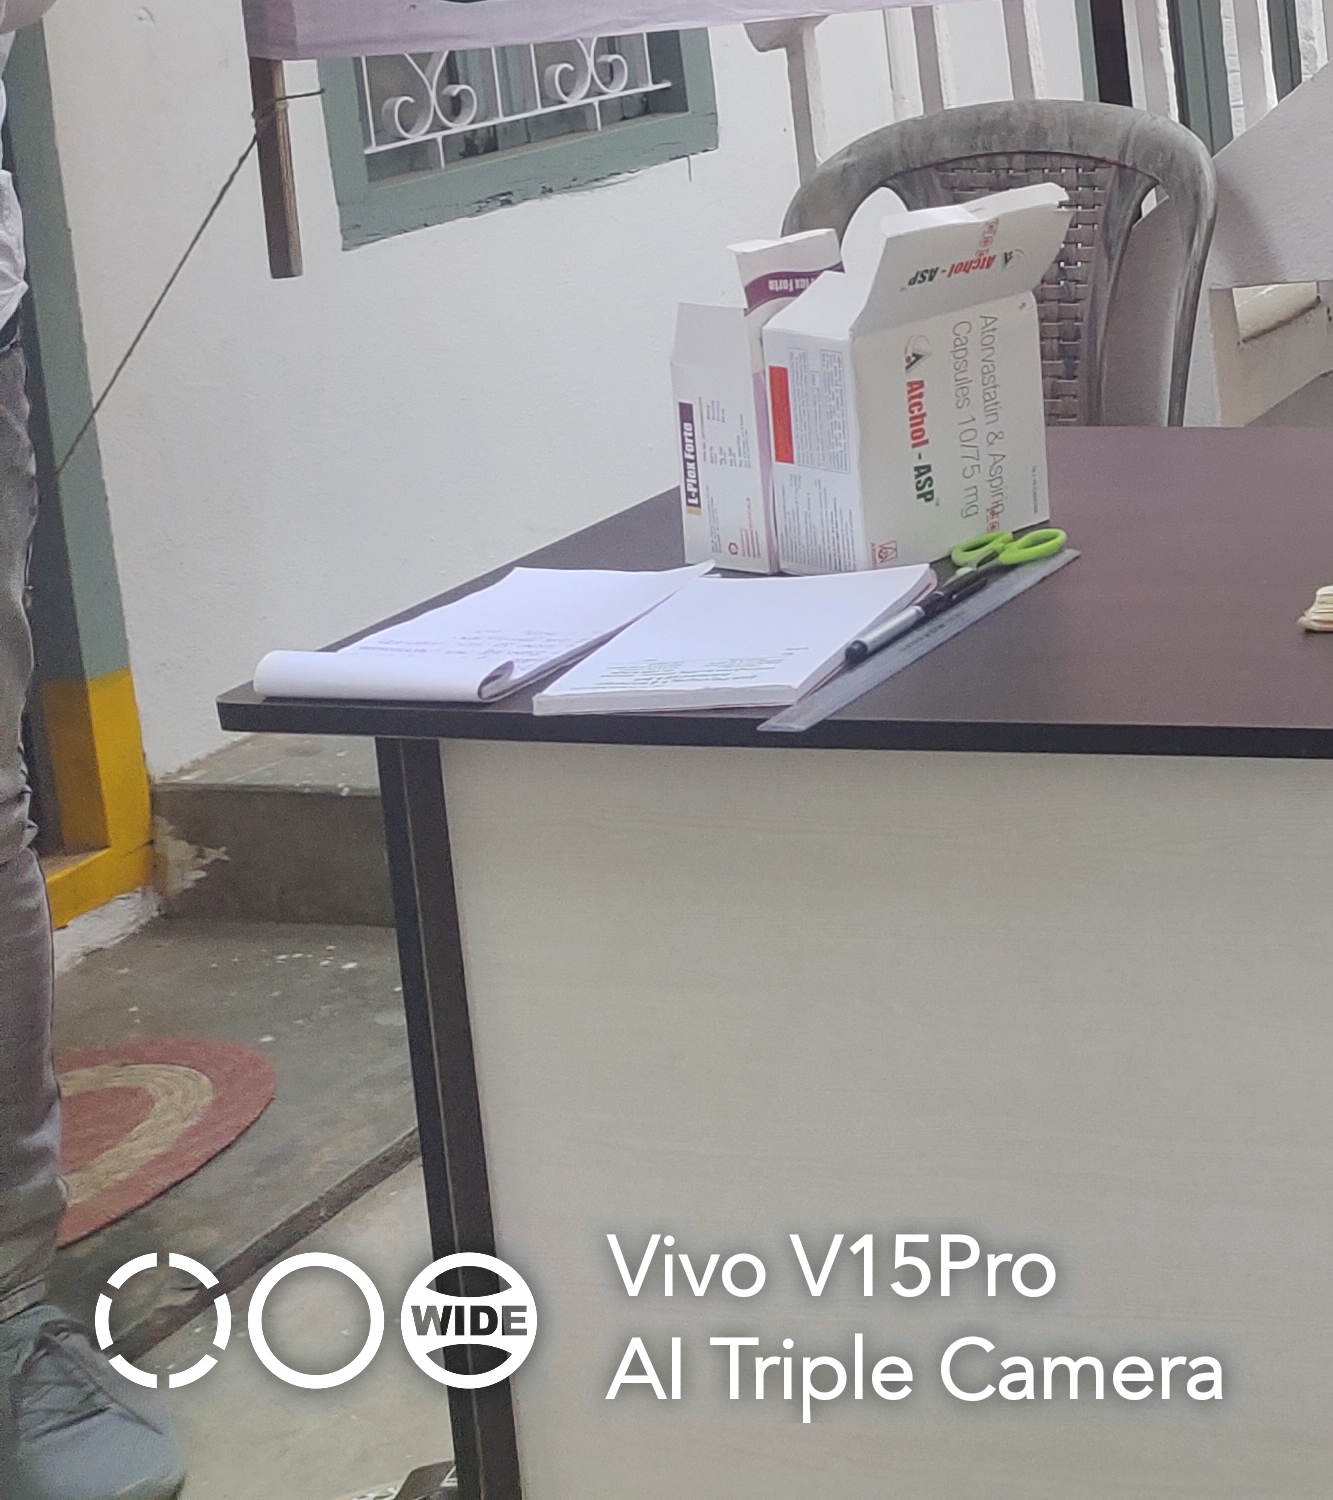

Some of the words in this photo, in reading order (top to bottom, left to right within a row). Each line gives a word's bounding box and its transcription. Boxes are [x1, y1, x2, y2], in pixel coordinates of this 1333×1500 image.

[946, 254, 997, 278] Atchol
[950, 321, 973, 409] Capsules
[979, 315, 1002, 426] Atorvastatin
[906, 380, 930, 449] Atchol
[986, 431, 1004, 449] &
[958, 415, 981, 480] 10/75
[913, 464, 935, 504] ASP
[961, 487, 979, 519] mg
